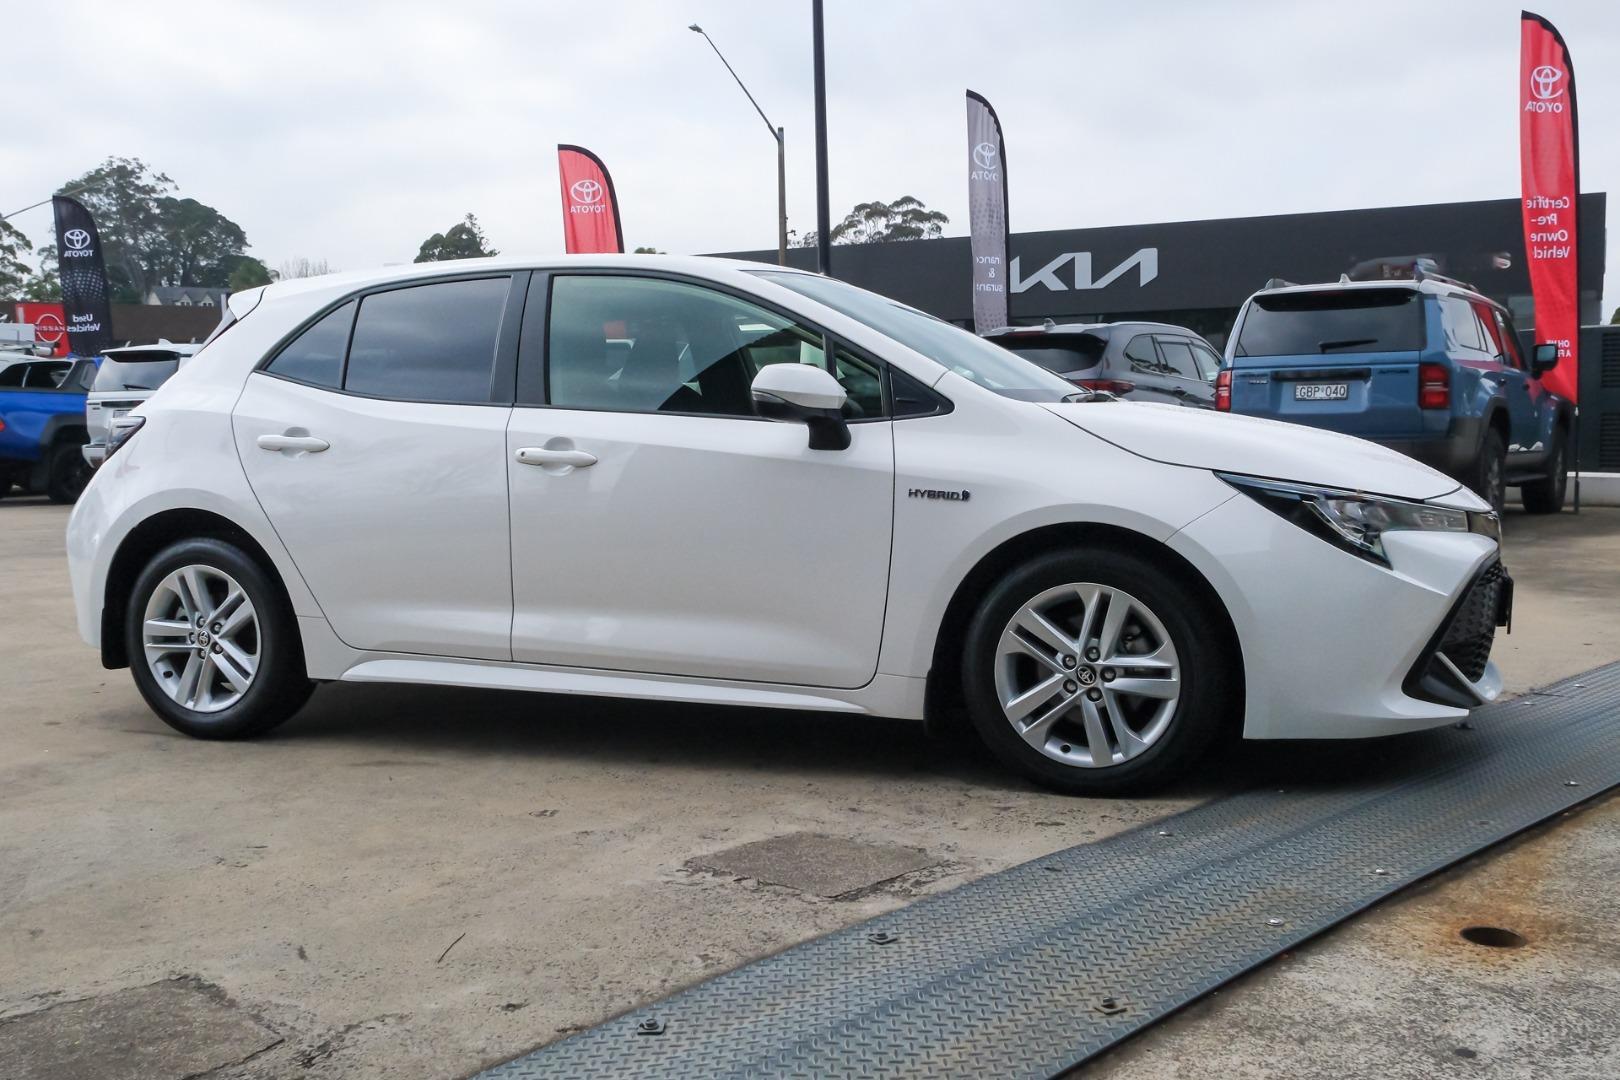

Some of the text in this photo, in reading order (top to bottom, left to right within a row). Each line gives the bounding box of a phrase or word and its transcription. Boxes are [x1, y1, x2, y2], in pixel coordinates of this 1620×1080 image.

[1010, 247, 1158, 294] KIA
[1299, 386, 1320, 398] GBP
[908, 488, 960, 501] HYBRID
